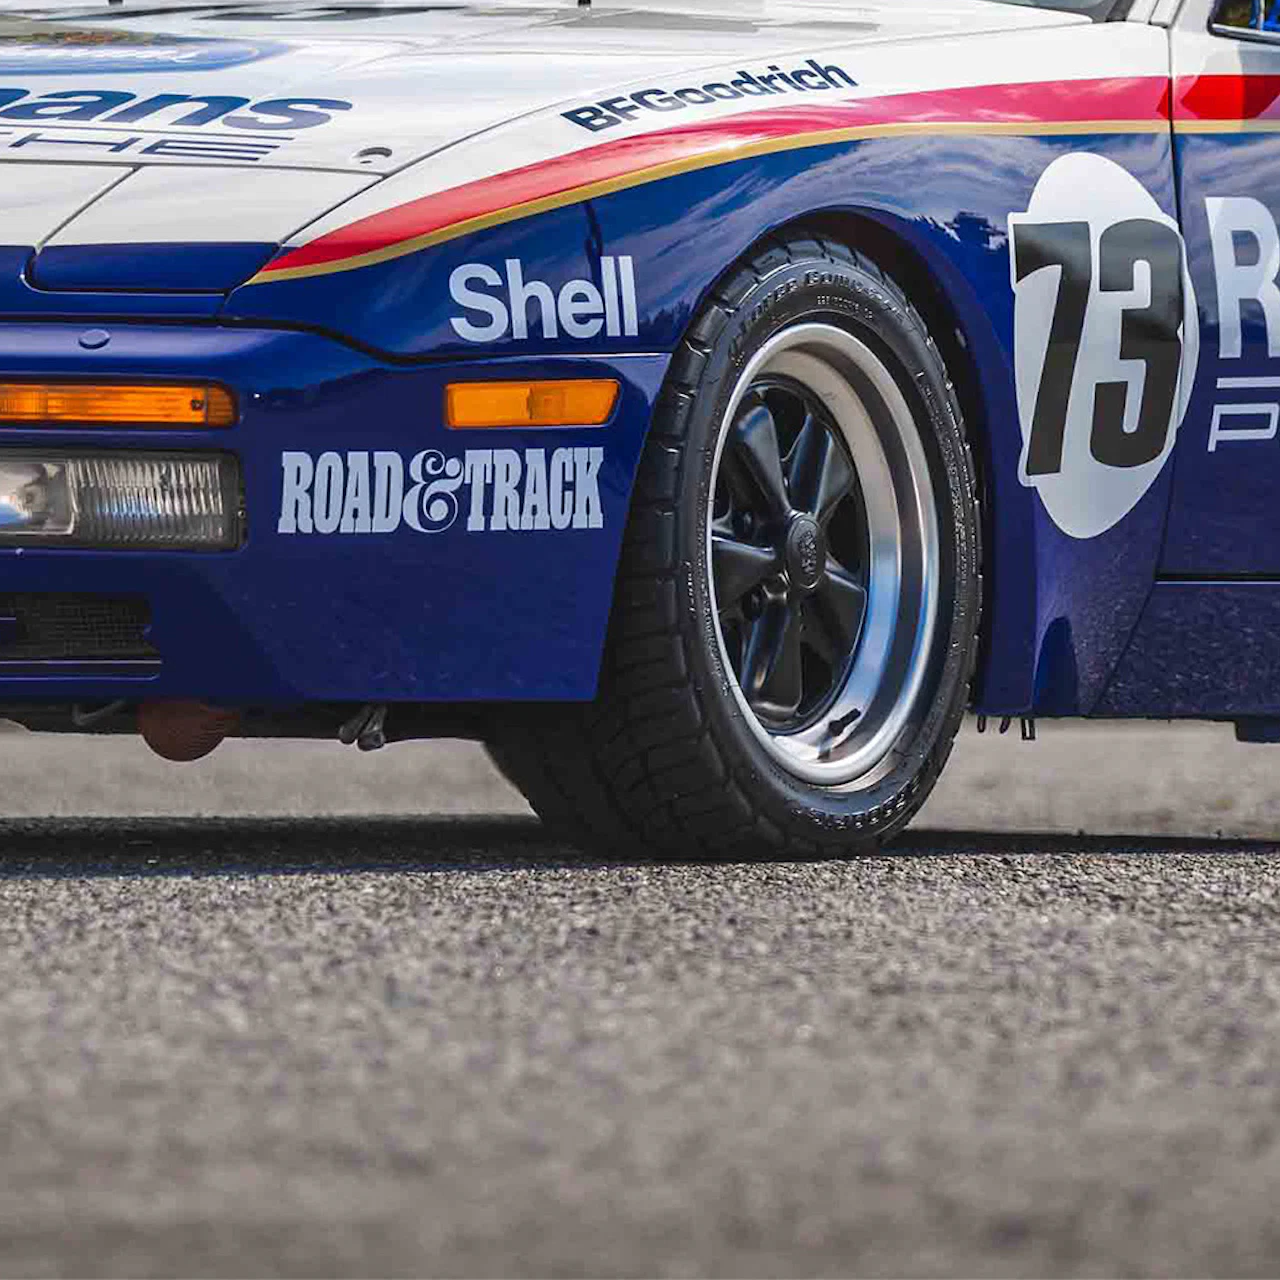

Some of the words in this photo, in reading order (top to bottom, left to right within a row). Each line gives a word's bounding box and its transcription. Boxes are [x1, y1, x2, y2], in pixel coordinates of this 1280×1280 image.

[560, 59, 859, 132] BFGoodrich
[450, 255, 638, 340] Shell
[1013, 218, 1184, 476] 73
